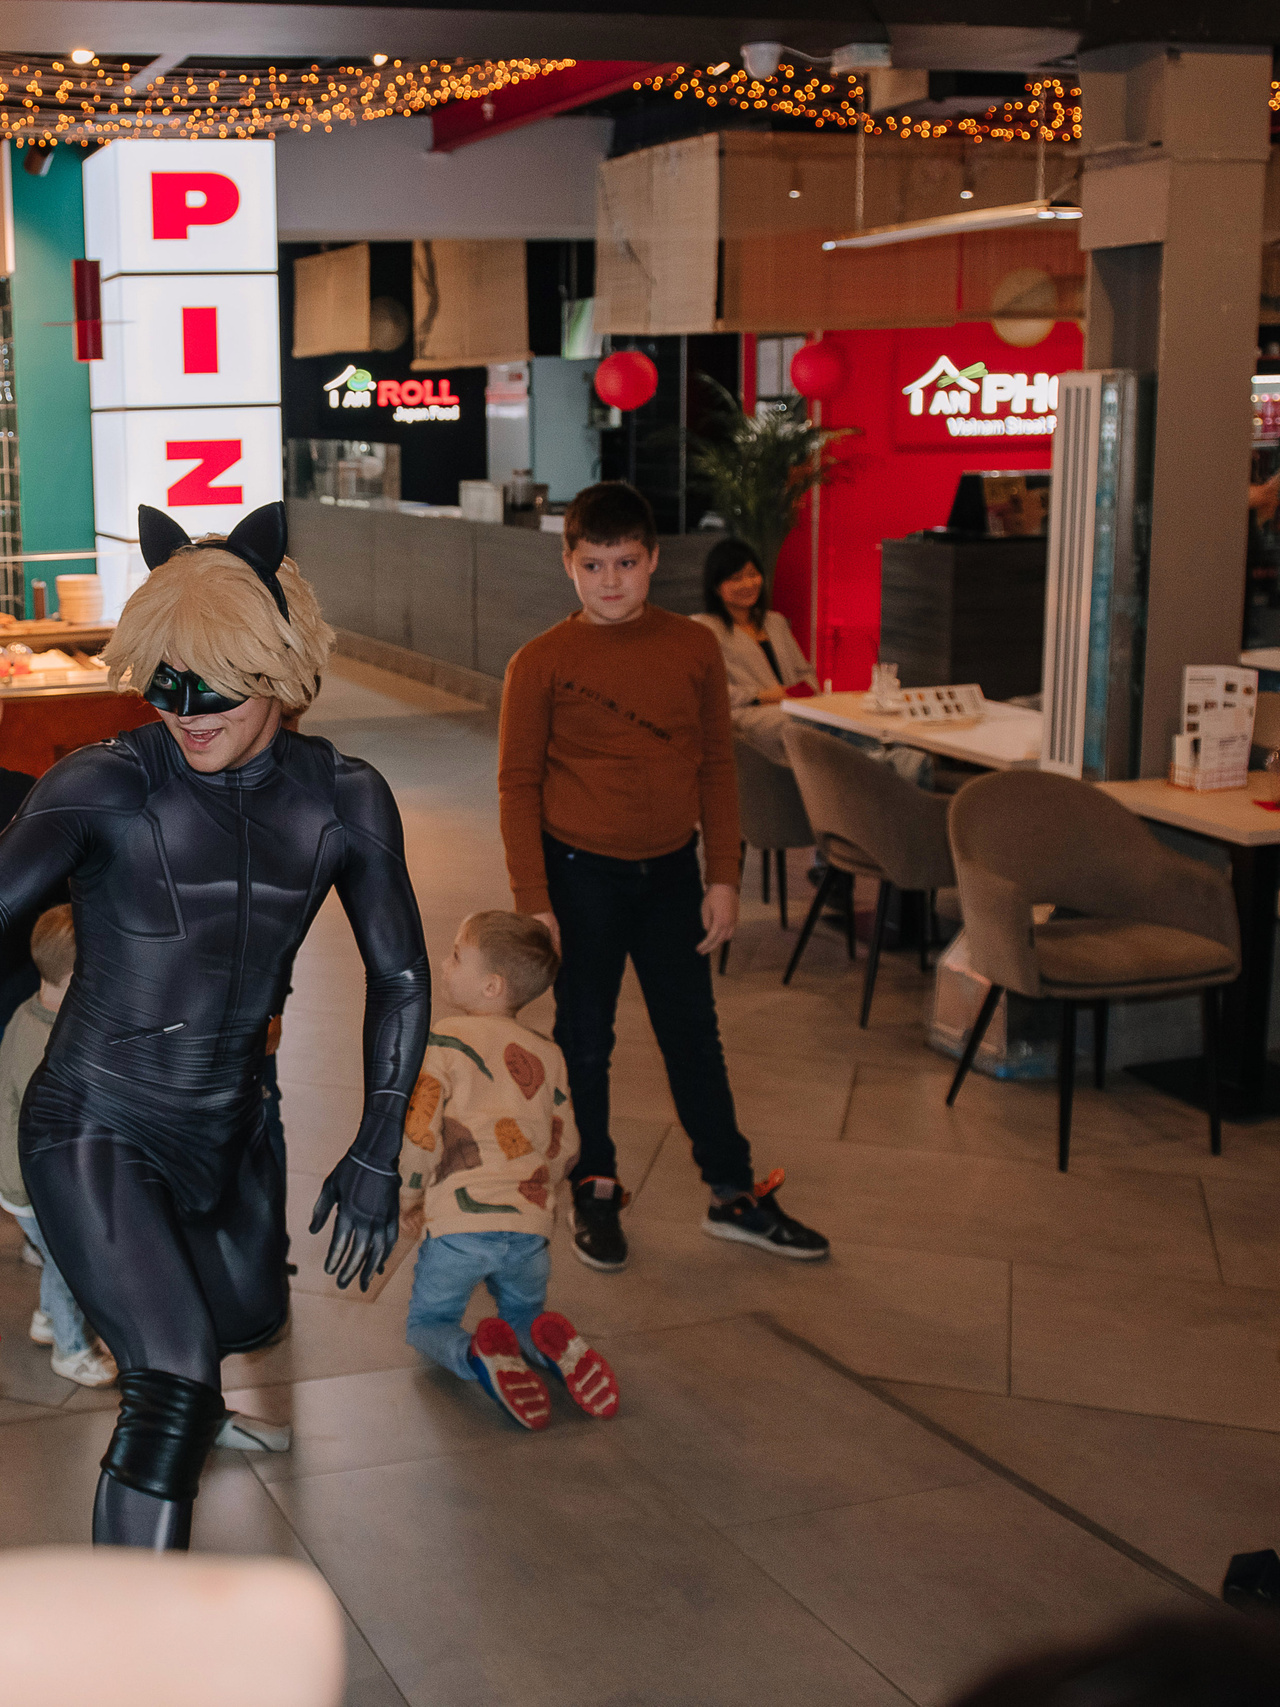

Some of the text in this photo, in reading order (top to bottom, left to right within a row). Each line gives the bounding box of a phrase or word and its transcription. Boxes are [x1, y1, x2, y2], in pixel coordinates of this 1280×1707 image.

[329, 379, 459, 408] I AM ROLL
[929, 390, 970, 415] AM
